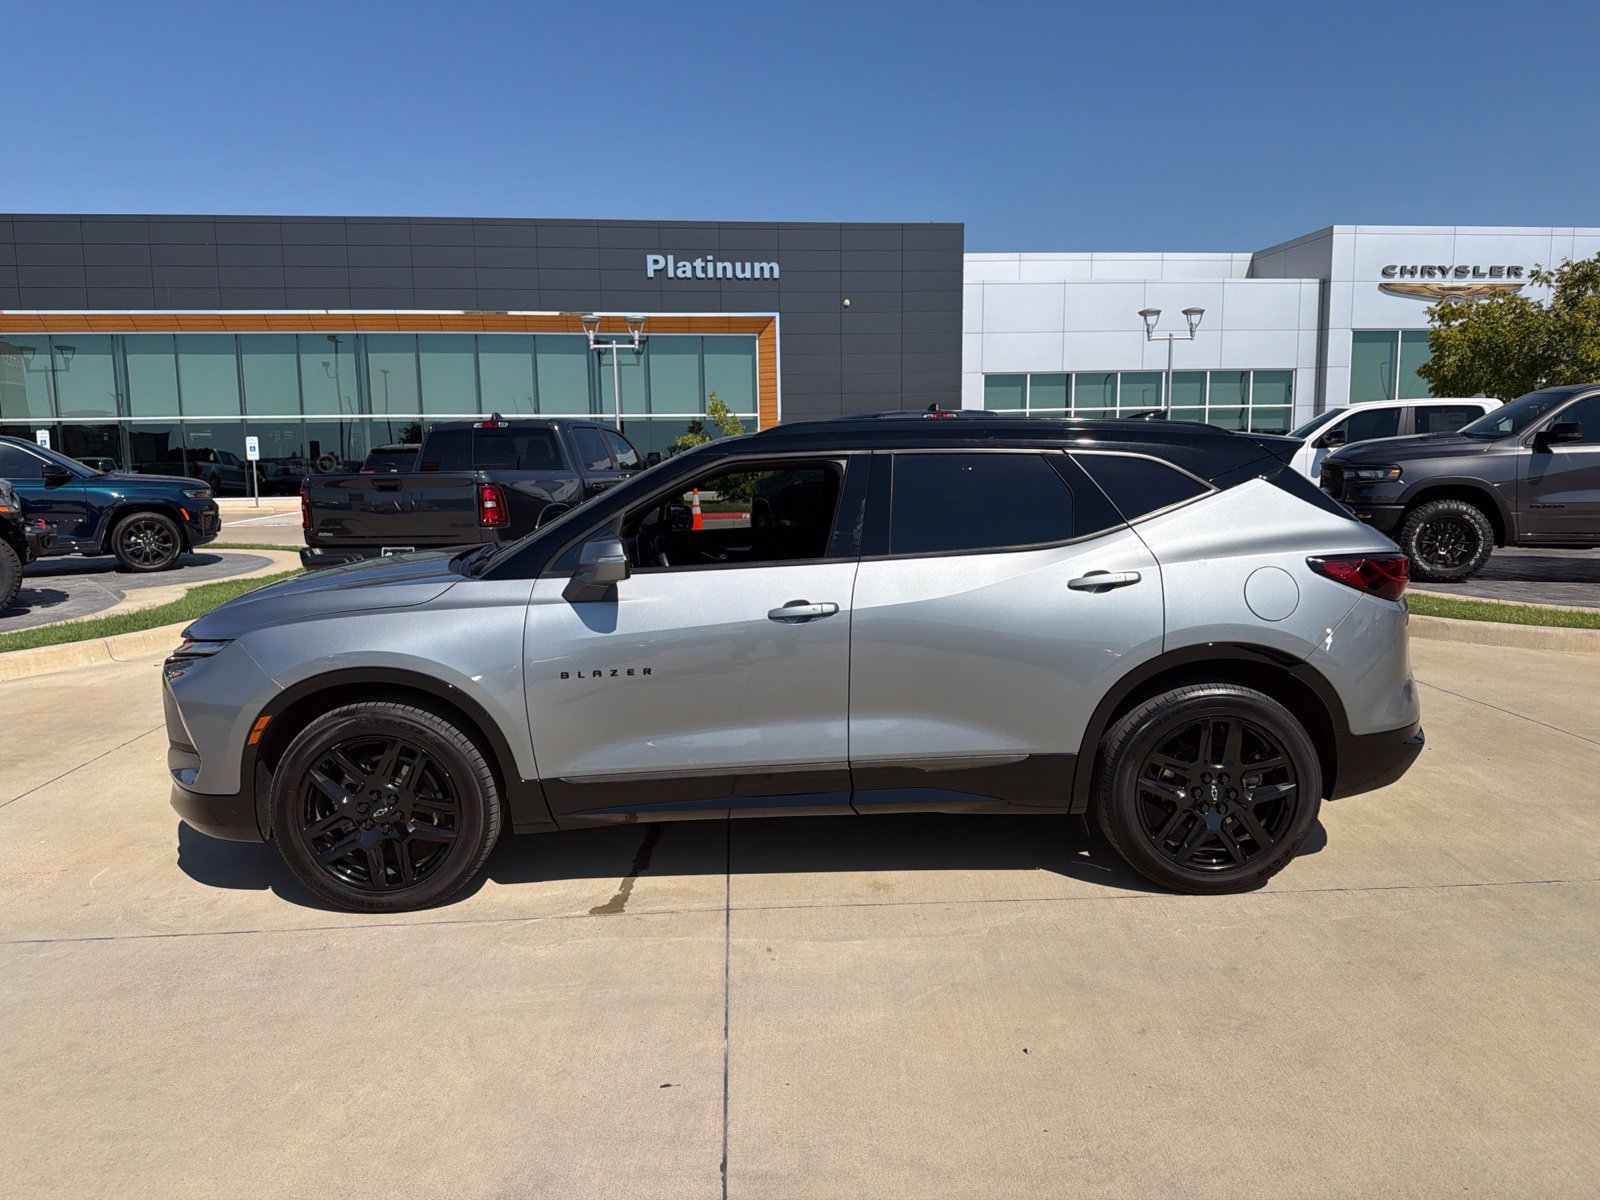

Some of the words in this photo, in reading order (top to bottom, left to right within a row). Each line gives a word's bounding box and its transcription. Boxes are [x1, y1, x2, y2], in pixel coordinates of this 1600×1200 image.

[646, 254, 780, 279] Platinum
[1381, 265, 1524, 279] CHRYSLER
[560, 667, 652, 680] BLAZER
